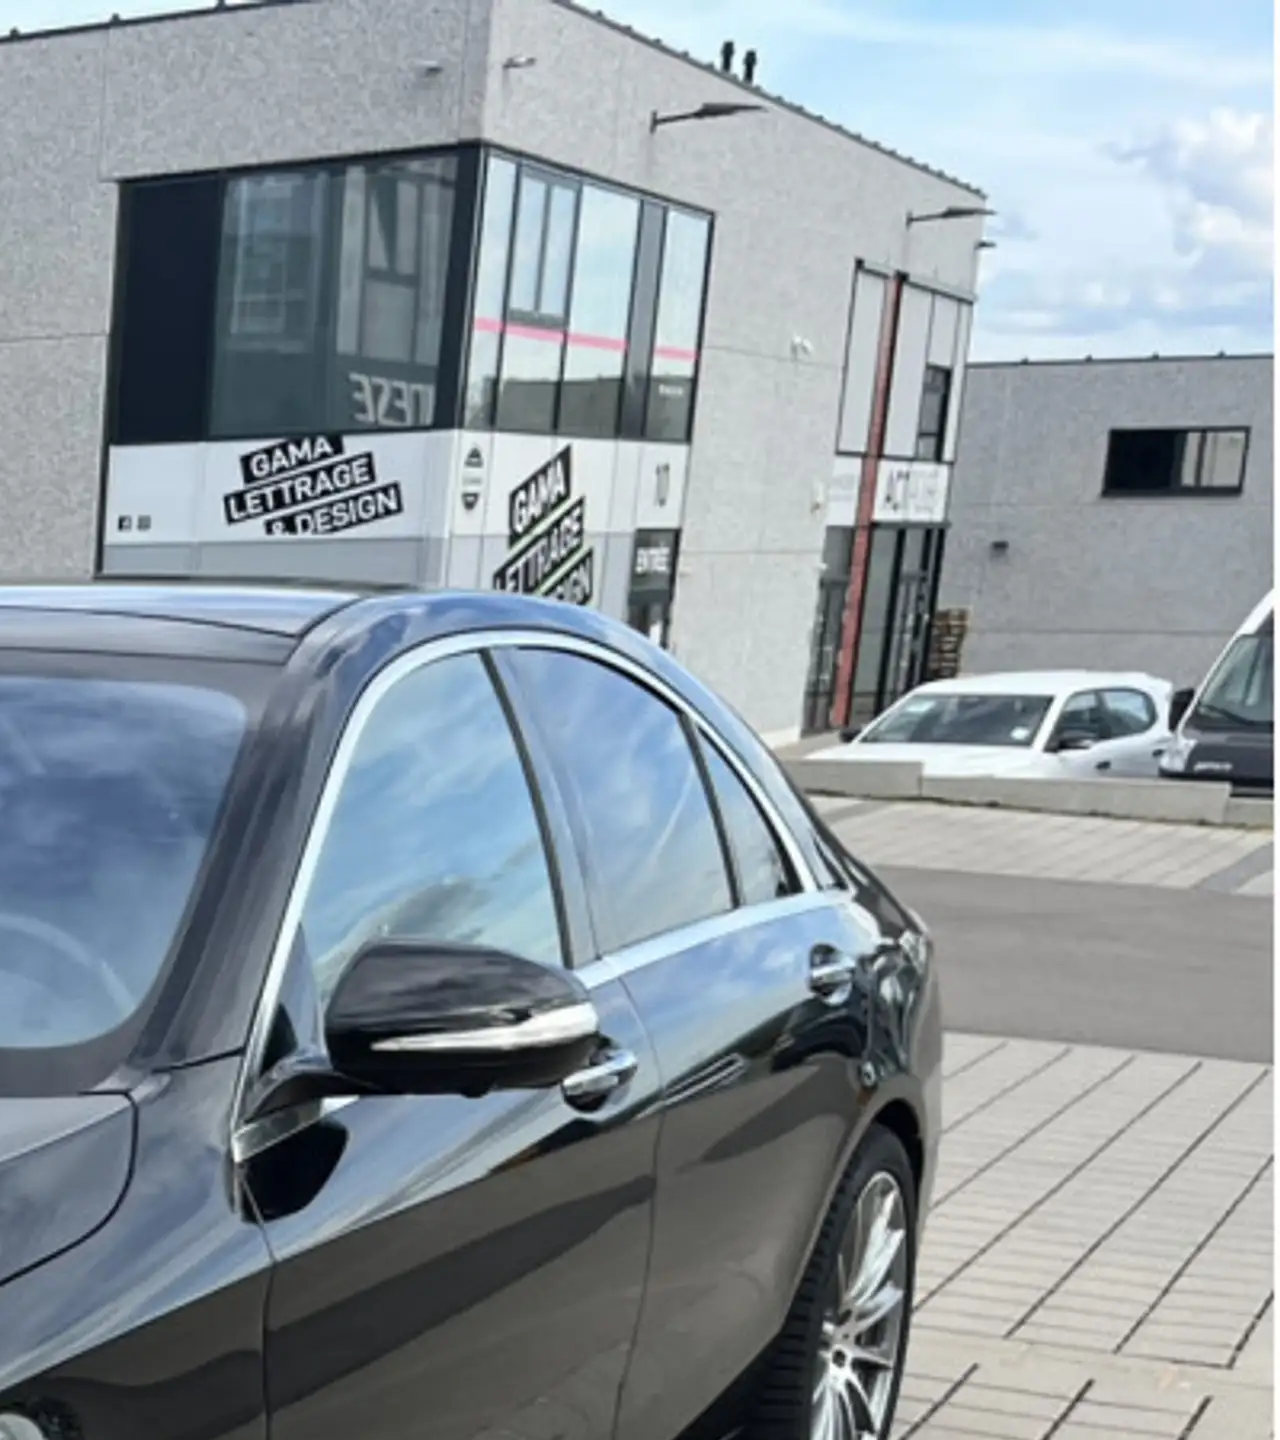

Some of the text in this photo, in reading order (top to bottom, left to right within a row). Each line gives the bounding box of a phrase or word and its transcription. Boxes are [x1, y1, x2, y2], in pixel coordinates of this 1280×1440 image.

[249, 435, 333, 478] GAMA
[228, 457, 371, 521] LETTRAGE
[294, 487, 398, 534] DESIGN
[512, 459, 567, 535] GAMA
